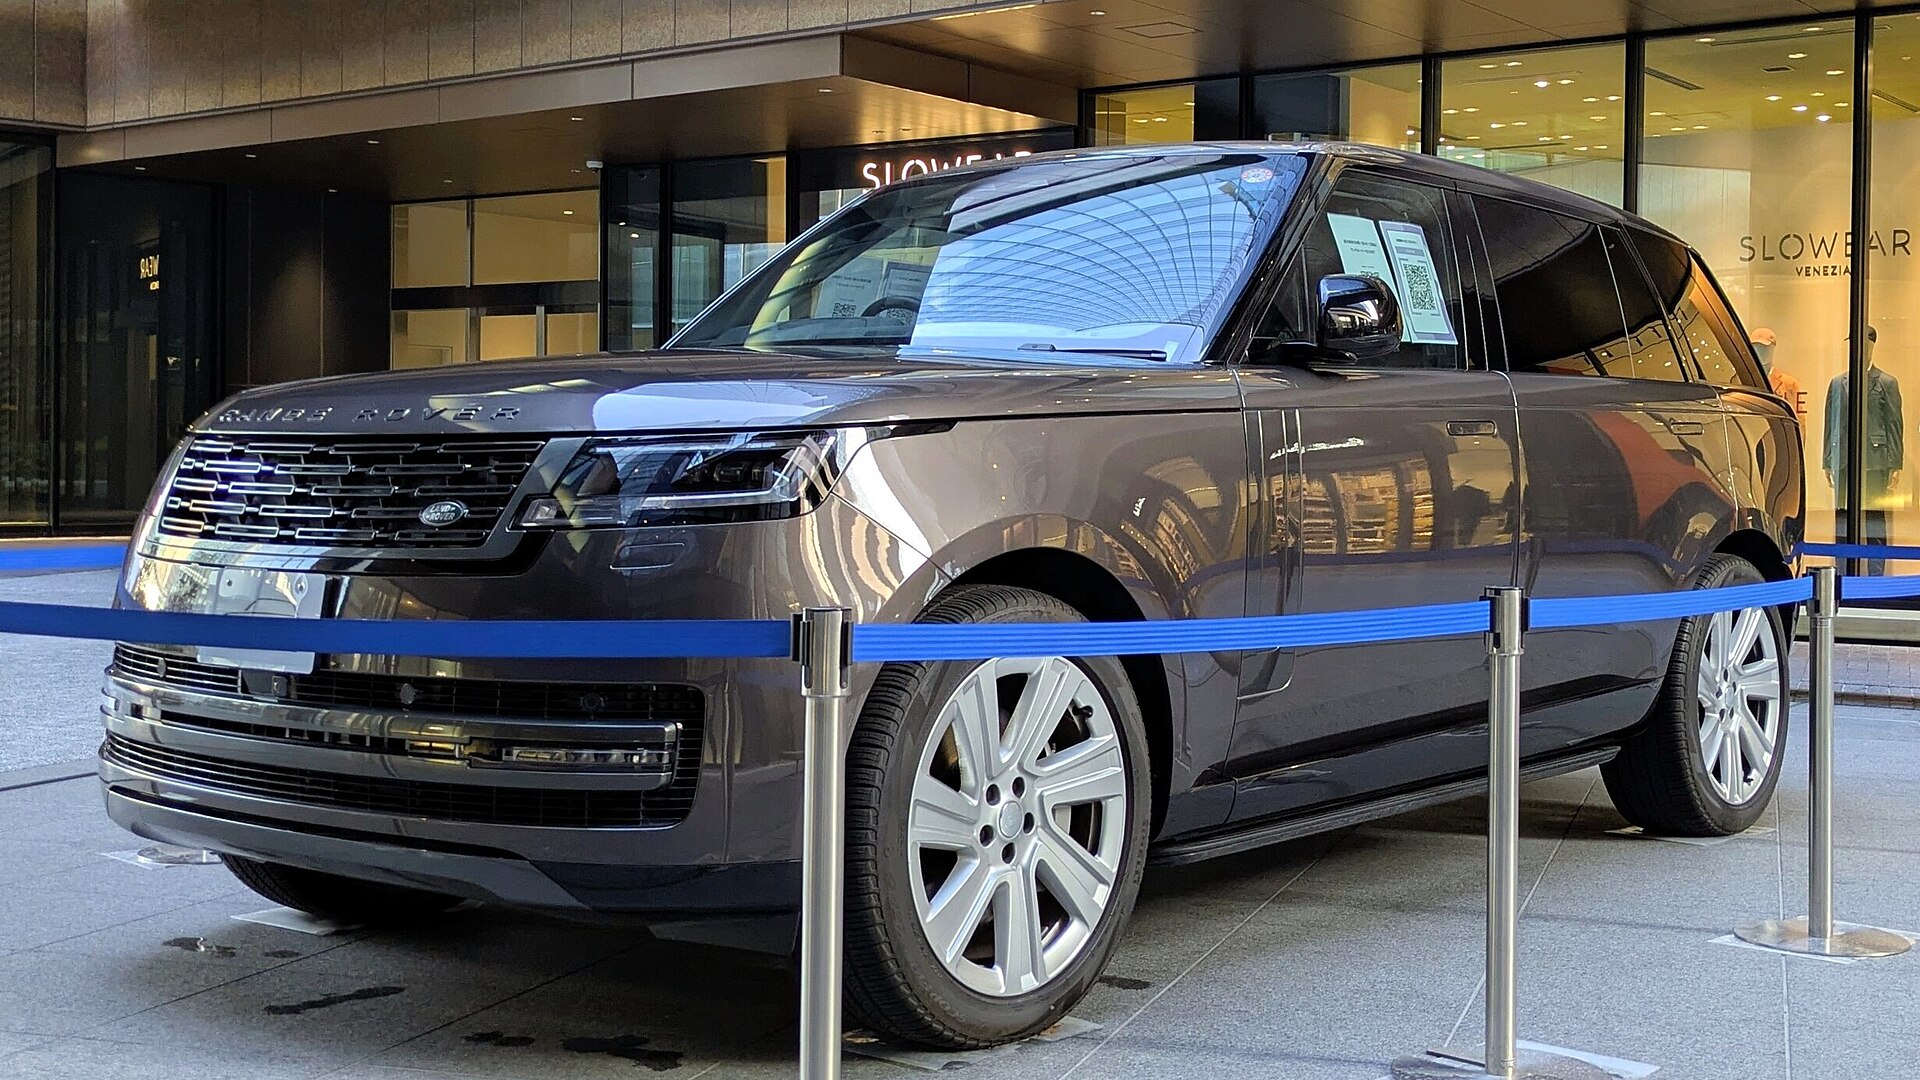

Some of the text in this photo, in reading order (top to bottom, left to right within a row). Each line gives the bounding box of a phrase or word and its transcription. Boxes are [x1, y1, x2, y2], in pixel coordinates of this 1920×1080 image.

[1795, 265, 1852, 277] VENEZIA
[219, 406, 521, 422] RANGE ROVER
[429, 504, 451, 512] LAND
[428, 512, 455, 520] ROVER
